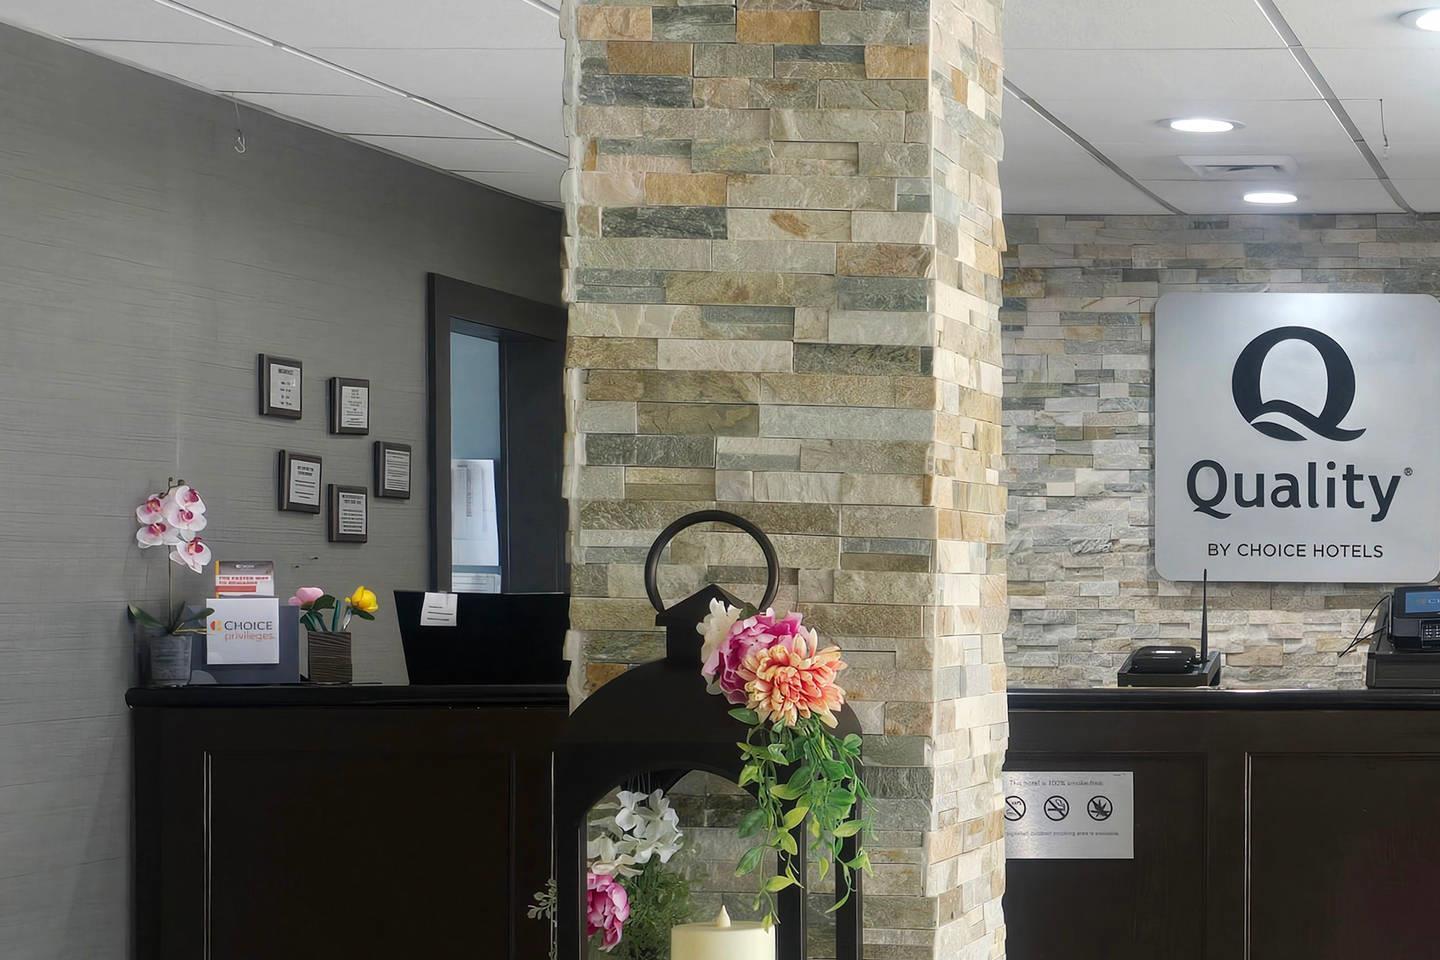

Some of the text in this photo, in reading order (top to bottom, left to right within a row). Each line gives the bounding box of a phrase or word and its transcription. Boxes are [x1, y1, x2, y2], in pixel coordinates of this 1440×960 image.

[1231, 325, 1367, 442] Q
[1186, 458, 1402, 523] Quality
[1207, 543, 1383, 558] BY CHOICE HOTELS
[224, 621, 273, 631] CHOICE
